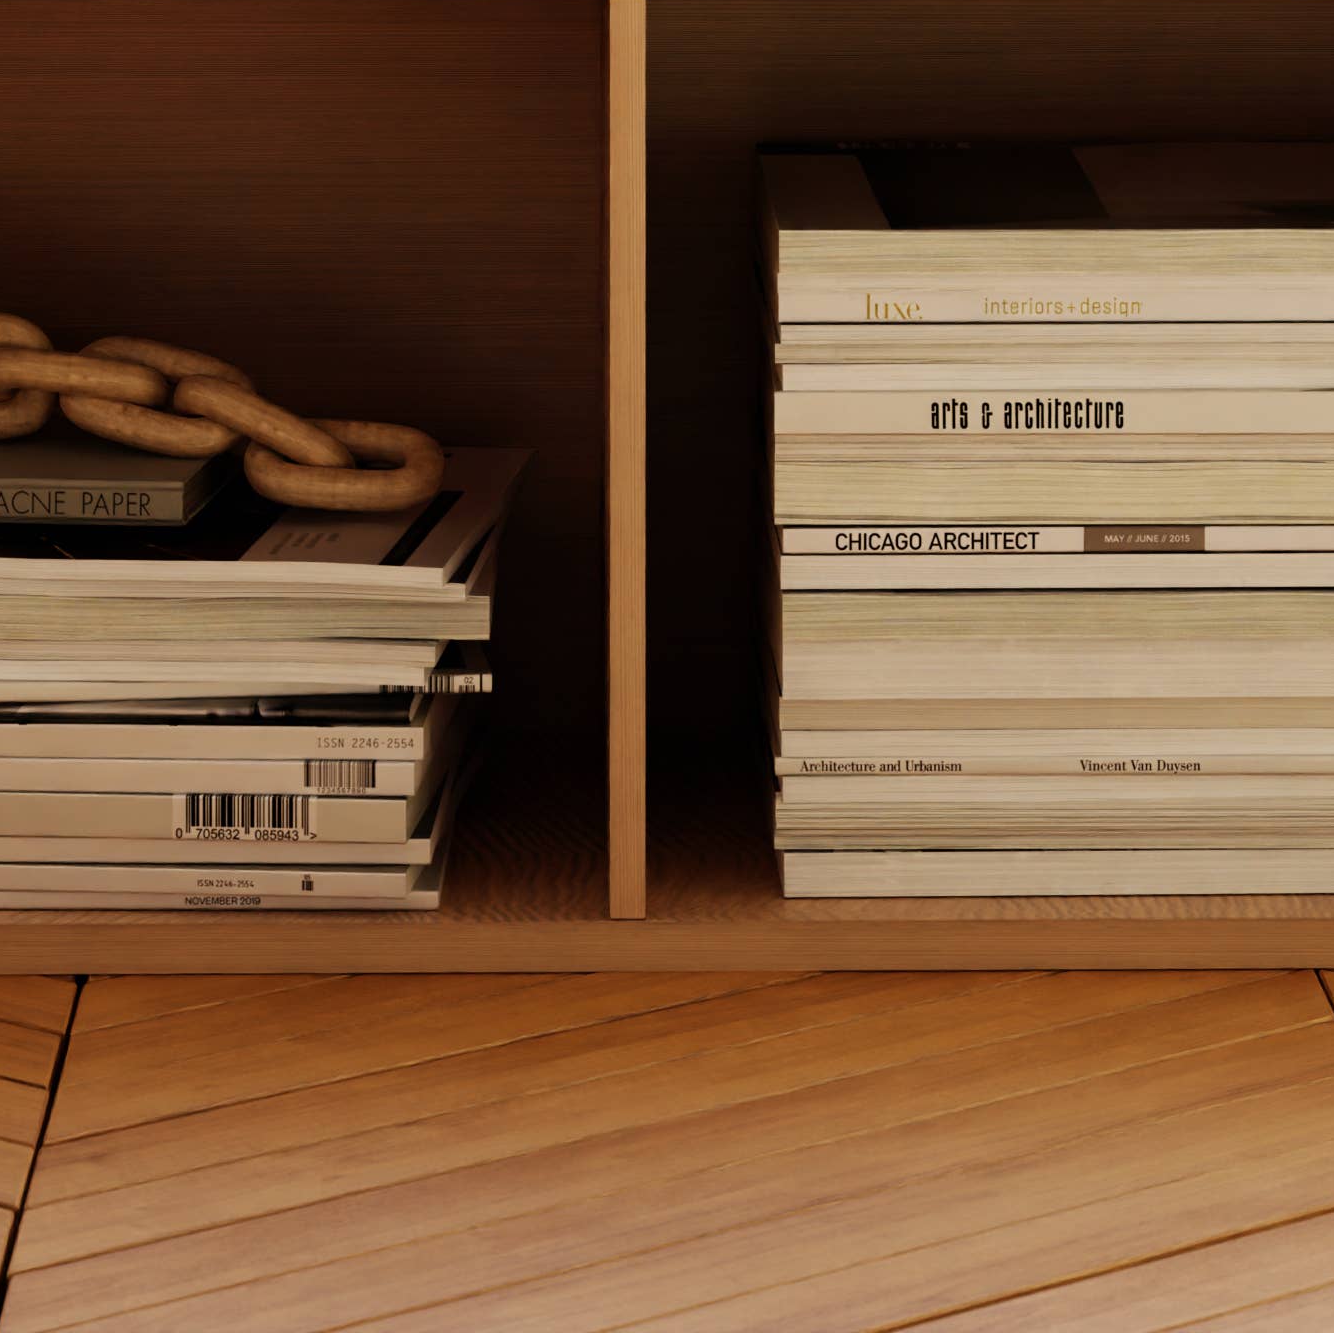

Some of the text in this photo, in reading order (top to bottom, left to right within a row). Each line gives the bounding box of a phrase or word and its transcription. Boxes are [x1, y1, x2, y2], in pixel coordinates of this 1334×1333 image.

[866, 293, 923, 320] luxe.
[931, 398, 1124, 429] arts & architecture
[82, 491, 151, 517] PAPER
[835, 532, 1040, 551] CHICAGO ARCHITECT
[1104, 534, 1125, 543] MAY
[1134, 534, 1160, 544] JUNE
[1169, 534, 1191, 543] 2015
[317, 737, 415, 750] ISSN 2246-2554
[800, 759, 963, 773] Architecture and Urbanism
[1079, 759, 1201, 774] Vincent Van Duysen
[175, 828, 299, 841] 0 705632 085943
[197, 879, 254, 888] ISSN 2246-2554
[185, 896, 261, 906] NOVEMBER 2019
